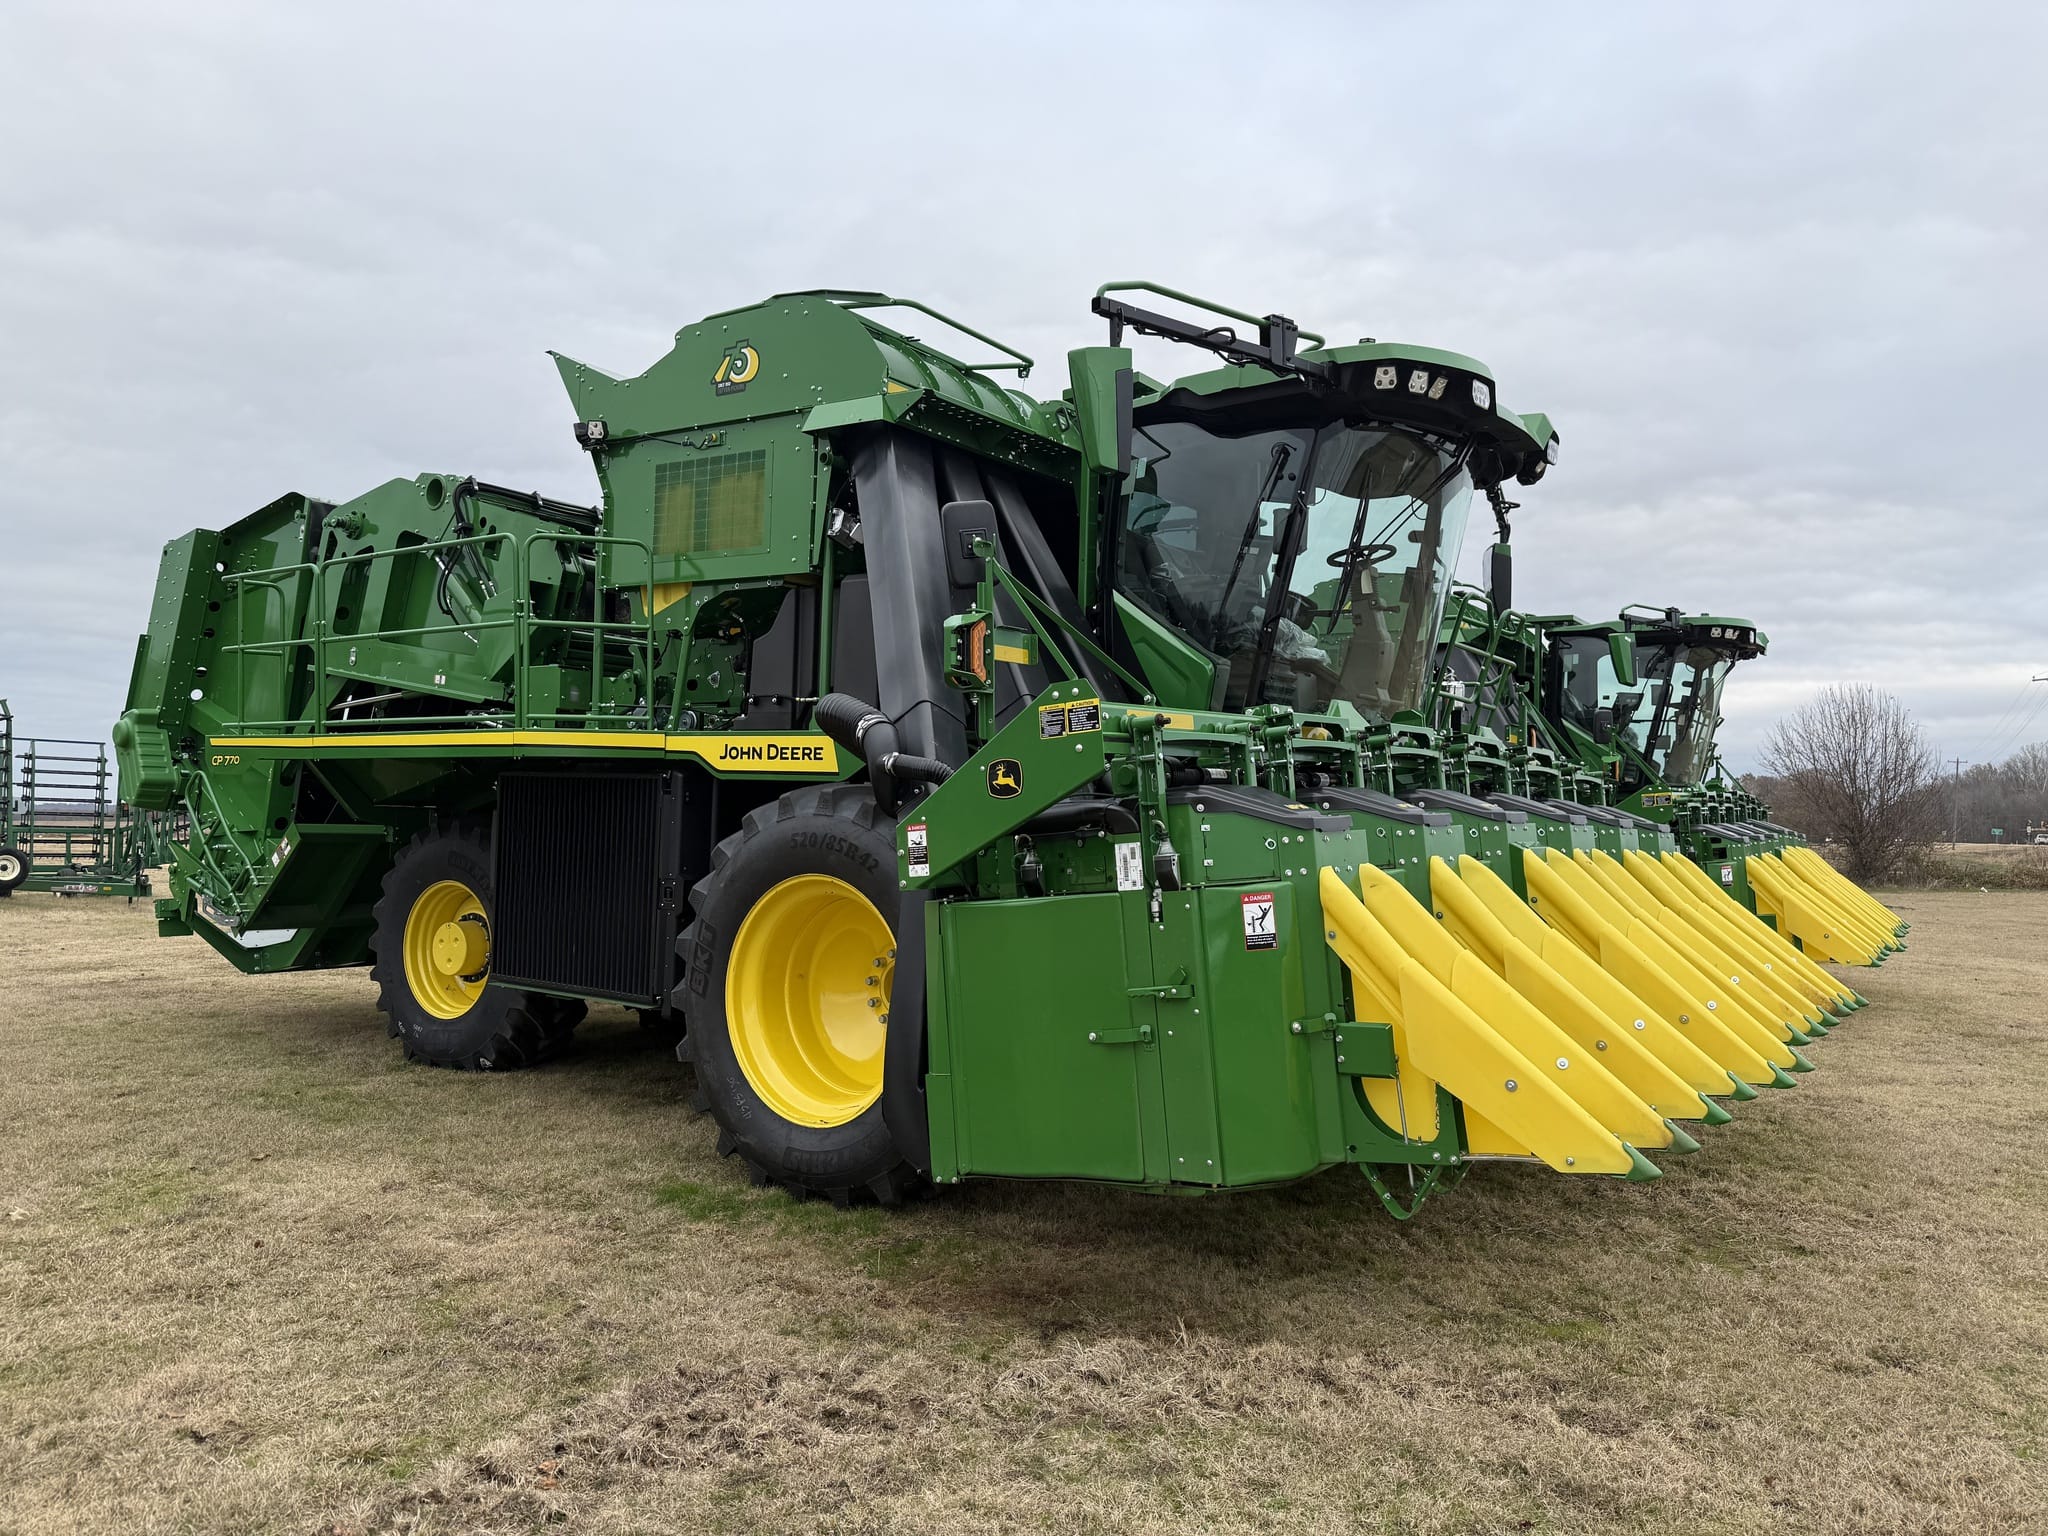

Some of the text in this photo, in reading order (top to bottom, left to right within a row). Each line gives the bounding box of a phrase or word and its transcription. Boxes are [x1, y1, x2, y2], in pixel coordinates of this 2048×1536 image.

[719, 743, 824, 761] JOHN DEERE
[211, 755, 240, 766] CP 770
